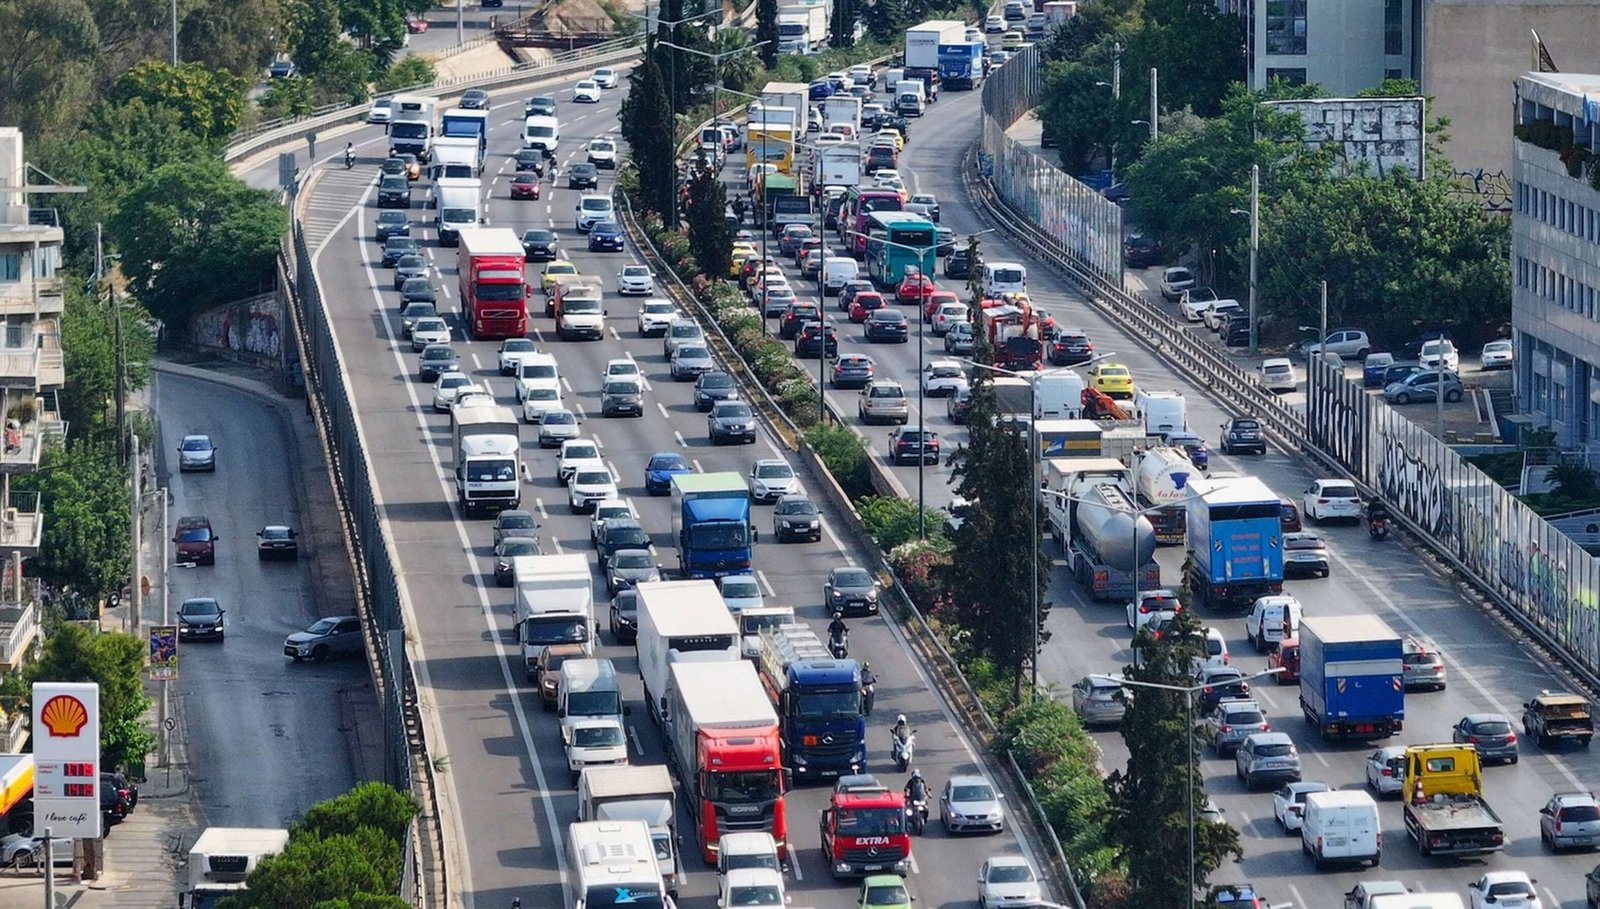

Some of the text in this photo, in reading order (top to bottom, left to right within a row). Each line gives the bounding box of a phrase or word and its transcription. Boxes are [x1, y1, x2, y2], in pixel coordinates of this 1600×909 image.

[49, 812, 67, 821] love
[69, 813, 88, 825] café
[855, 836, 890, 846] EXTRA
